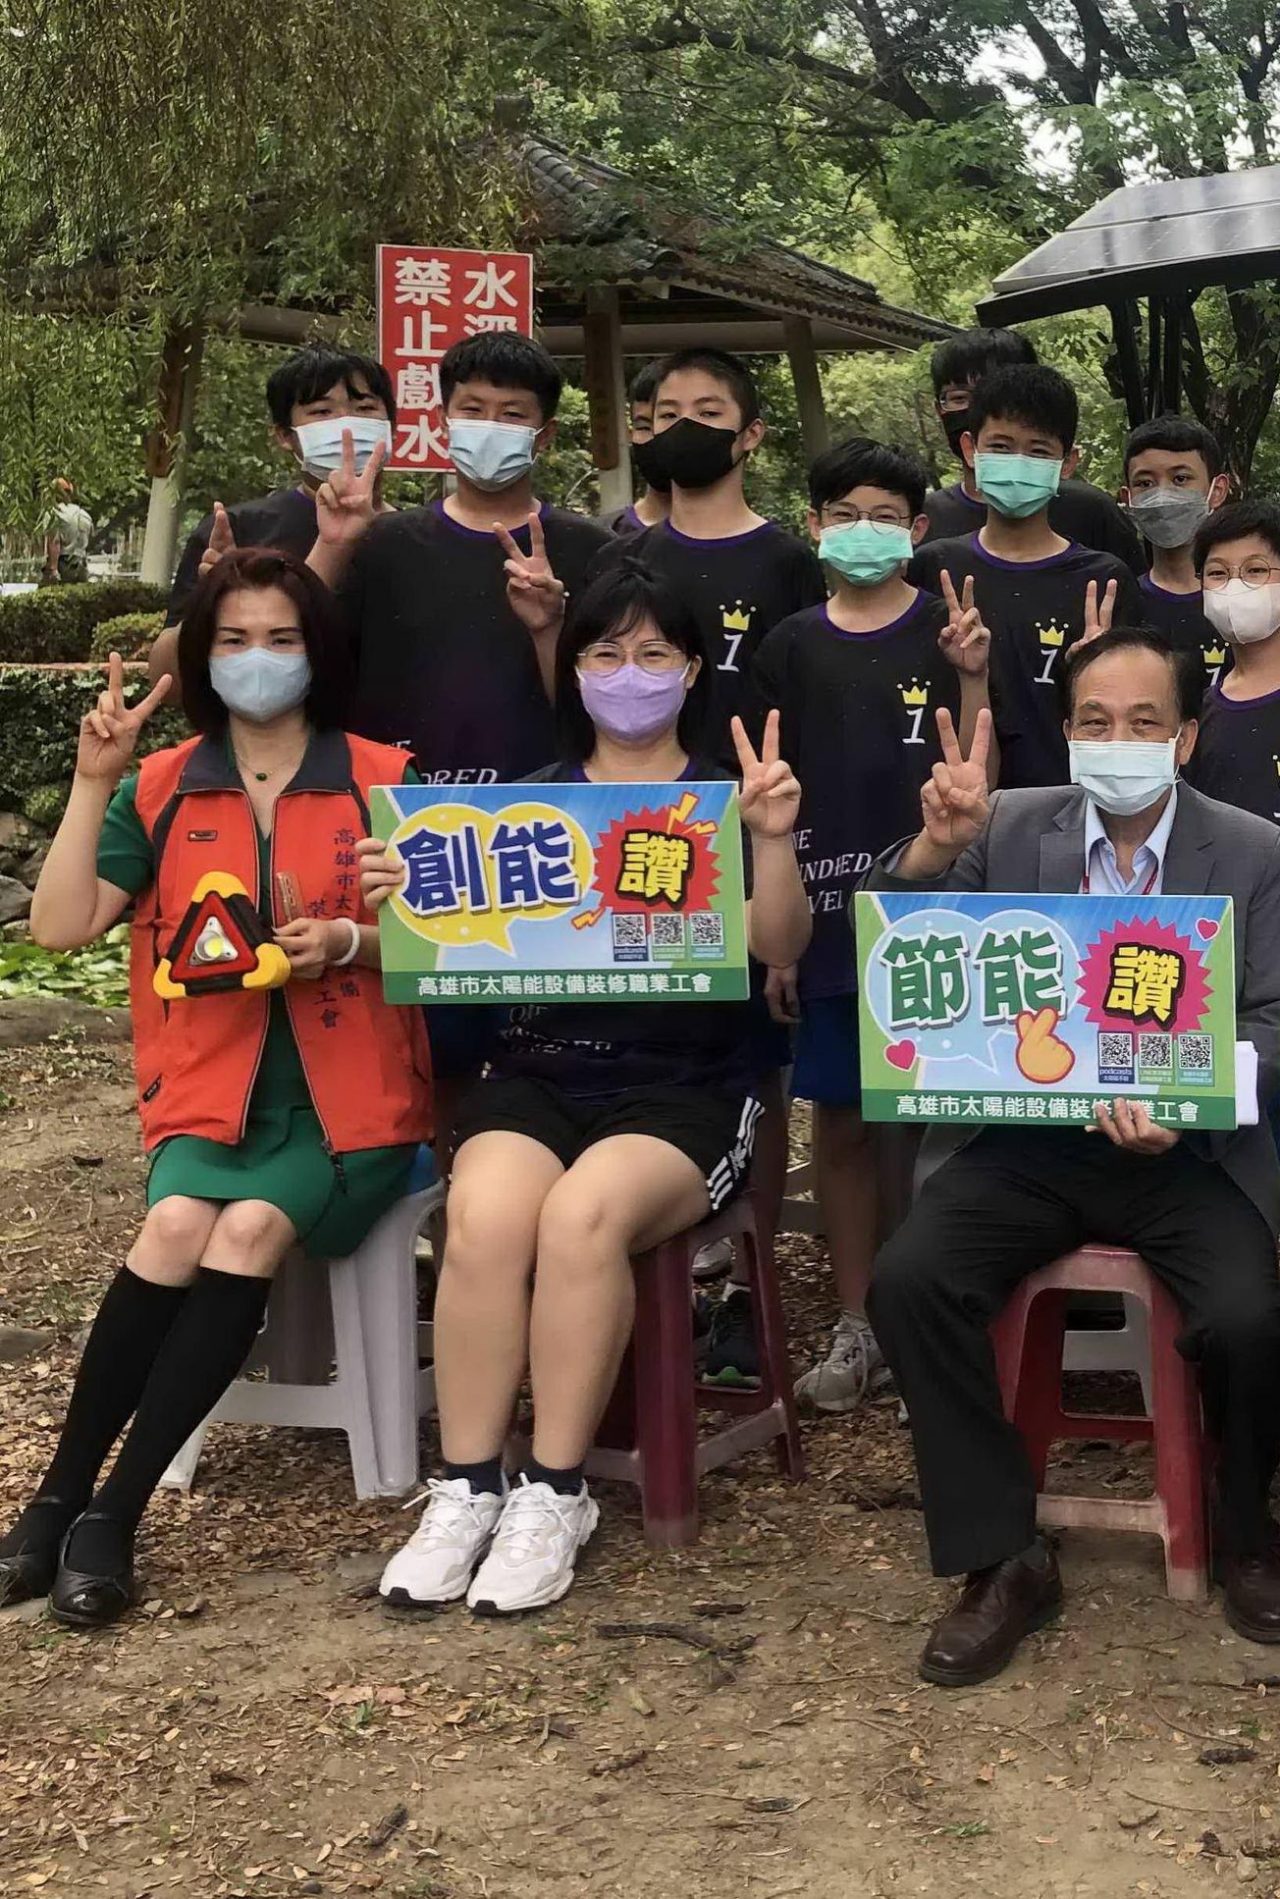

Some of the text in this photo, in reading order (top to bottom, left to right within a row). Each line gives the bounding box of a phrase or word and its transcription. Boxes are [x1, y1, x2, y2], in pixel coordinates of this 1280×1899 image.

[394, 256, 452, 464] 禁止戲水
[716, 633, 744, 673] 1
[1033, 648, 1058, 685] 1
[901, 707, 926, 745] 1
[396, 819, 690, 915] 創能 讚
[417, 972, 713, 998] 高雄市太陽能設備裝修職業工會
[881, 929, 1180, 1024] 節能 讚
[896, 1094, 1199, 1123] 高雄市太陽能設備裝修業工會
